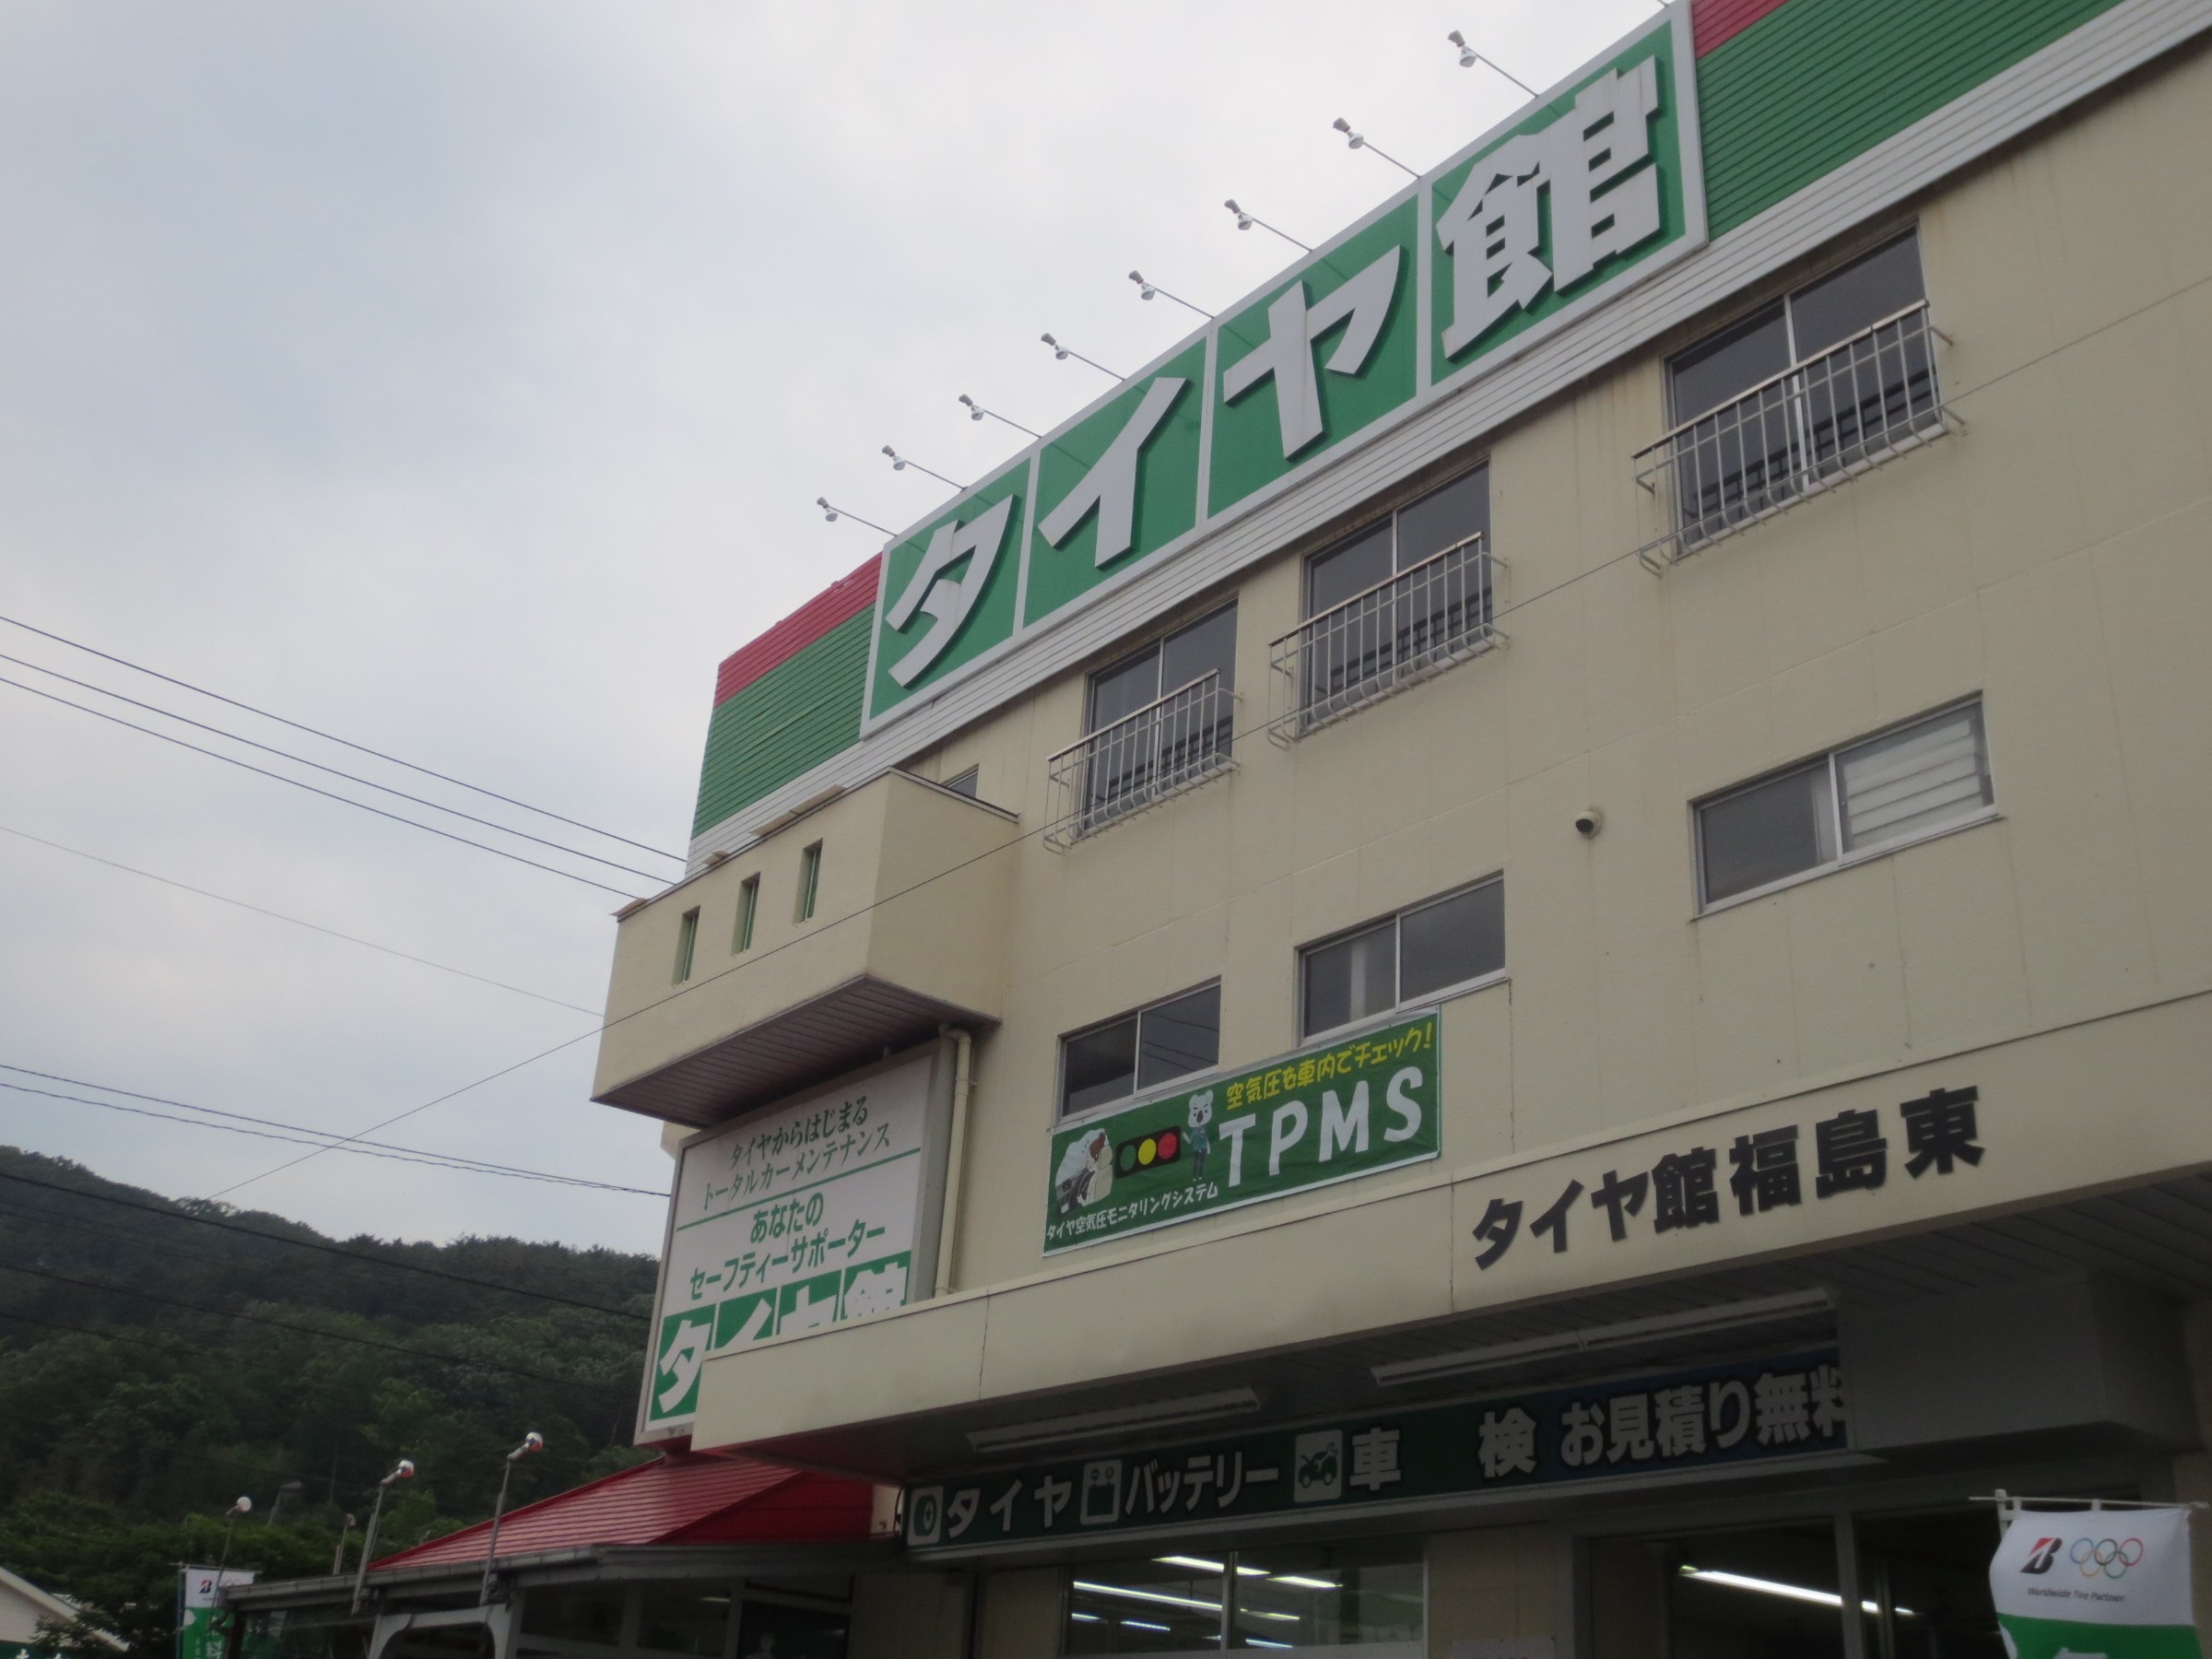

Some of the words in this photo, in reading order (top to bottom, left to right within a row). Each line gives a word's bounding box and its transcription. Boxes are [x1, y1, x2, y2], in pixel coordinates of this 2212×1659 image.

[885, 54, 1660, 688] タイヤ館
[703, 1122, 890, 1211] トータルカーメンテナンス
[730, 1095, 868, 1171] タイヤからはじまる
[1218, 1065, 1423, 1187] TPMS
[749, 1192, 825, 1244] あなたの
[1046, 1181, 1218, 1241] タイヤ空気圧モニタリングシステム
[1472, 1085, 1985, 1270] タイヤ館福島東
[689, 1218, 887, 1300] セーフティーサポーター
[946, 1475, 1072, 1539] タイヤ
[1124, 1451, 1279, 1515] バッテリー
[2028, 1586, 2071, 1599] Worldwide
[2074, 1590, 2088, 1600] Tire
[2091, 1591, 2125, 1603] Partner
